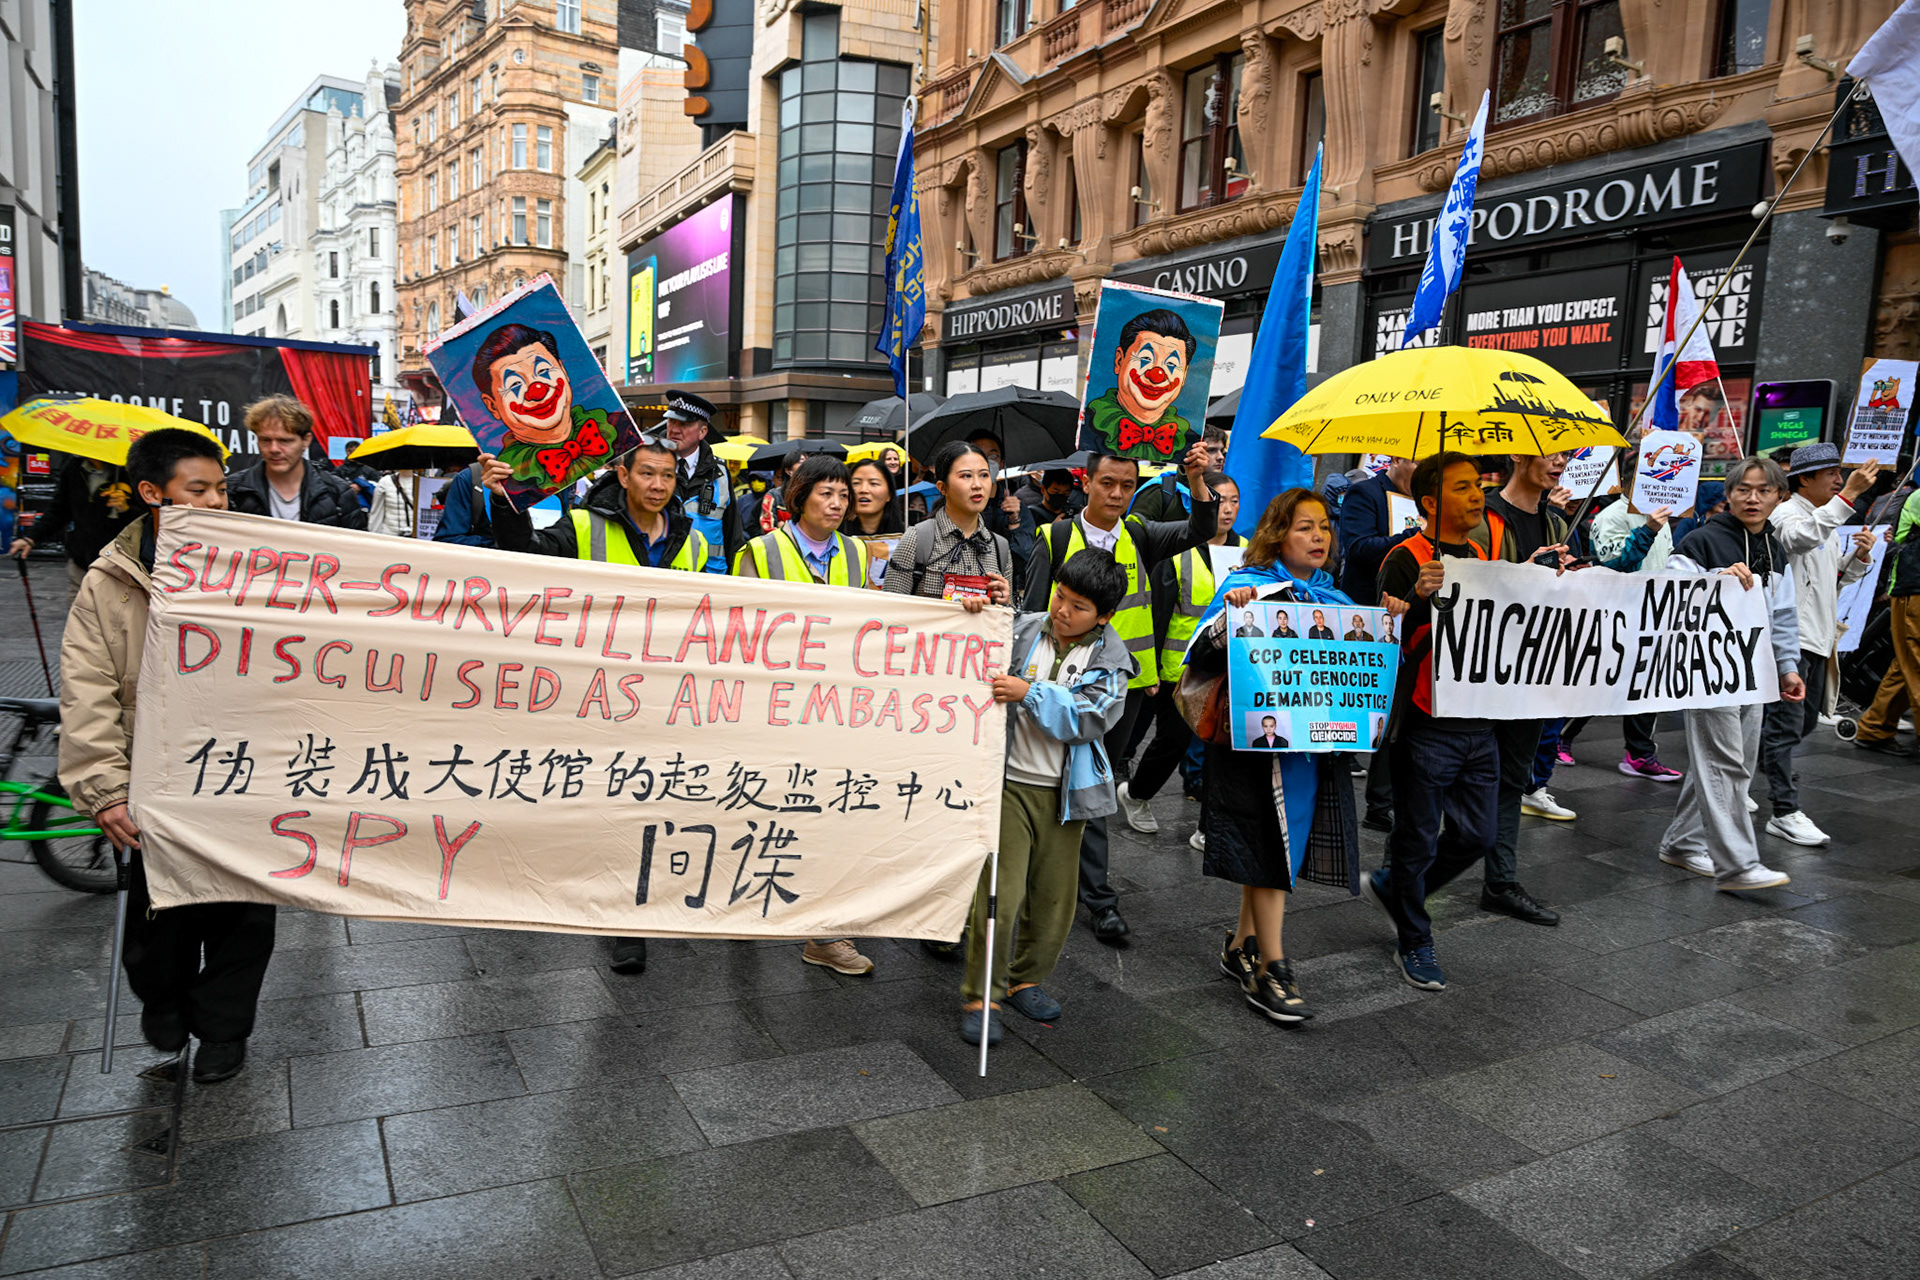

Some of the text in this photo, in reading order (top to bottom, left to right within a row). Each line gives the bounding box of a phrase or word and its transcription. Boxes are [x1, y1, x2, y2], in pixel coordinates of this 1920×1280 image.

[1154, 256, 1248, 294] CASINO
[1689, 269, 1714, 277] TATUM
[951, 295, 1062, 337] HIPPODROME
[1467, 297, 1618, 331] MORE THAN YOU EXPECT.
[1468, 323, 1612, 350] EVERYTHING YOU WANT.
[1213, 360, 1235, 373] ounge
[1355, 387, 1443, 405] ONLY ONE
[200, 400, 230, 426] TO
[1777, 421, 1804, 429] VEGAS
[1644, 491, 1683, 499] TRANSNATIONAL
[1649, 497, 1678, 505] REPRESSION
[1668, 485, 1689, 493] CHINA'S
[162, 540, 832, 672] SUPER-SURVEILLANCE
[1640, 578, 1735, 632] MEGA
[853, 618, 1004, 684] CENTRE
[1435, 596, 1626, 686] NO CHINA'S
[1250, 648, 1387, 670] CCP CELEBRATES,
[1627, 627, 1764, 701] EMBASSY
[177, 621, 995, 746] DISGUISED AS AN EMBASSY
[1272, 670, 1379, 688] BUT GENOCIDE
[1254, 691, 1388, 710] DEMANDS JUSTICE
[1310, 730, 1357, 742] GENOCIDE
[185, 733, 974, 822] 伪装成大使馆的超级监控中心
[269, 809, 483, 900] SPY
[635, 820, 802, 918] 间谍
